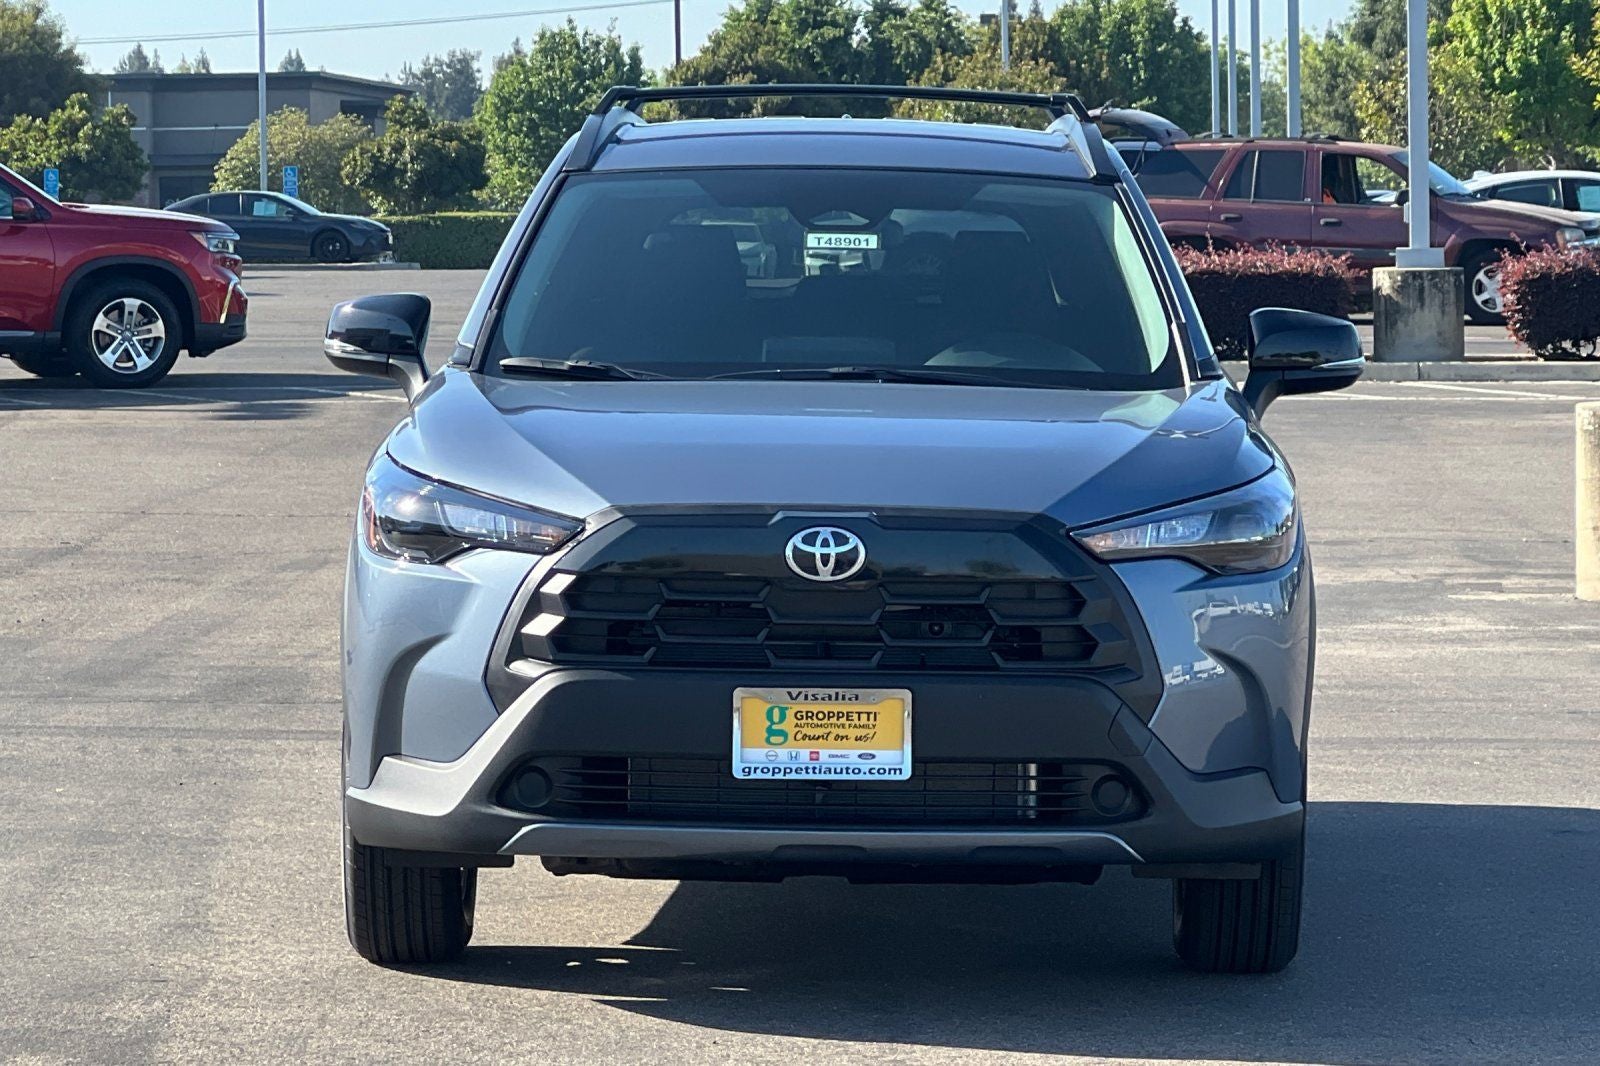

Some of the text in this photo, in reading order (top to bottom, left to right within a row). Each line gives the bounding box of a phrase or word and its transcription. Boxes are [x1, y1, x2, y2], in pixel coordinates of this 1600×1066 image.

[814, 236, 870, 247] T48901
[786, 691, 859, 701] Visalia
[793, 710, 877, 722] GROPPETTI
[765, 705, 789, 746] g
[793, 722, 846, 730] AUTOMOTIVE
[793, 730, 877, 743] Count on us!
[741, 765, 903, 777] groppettiauto.com
